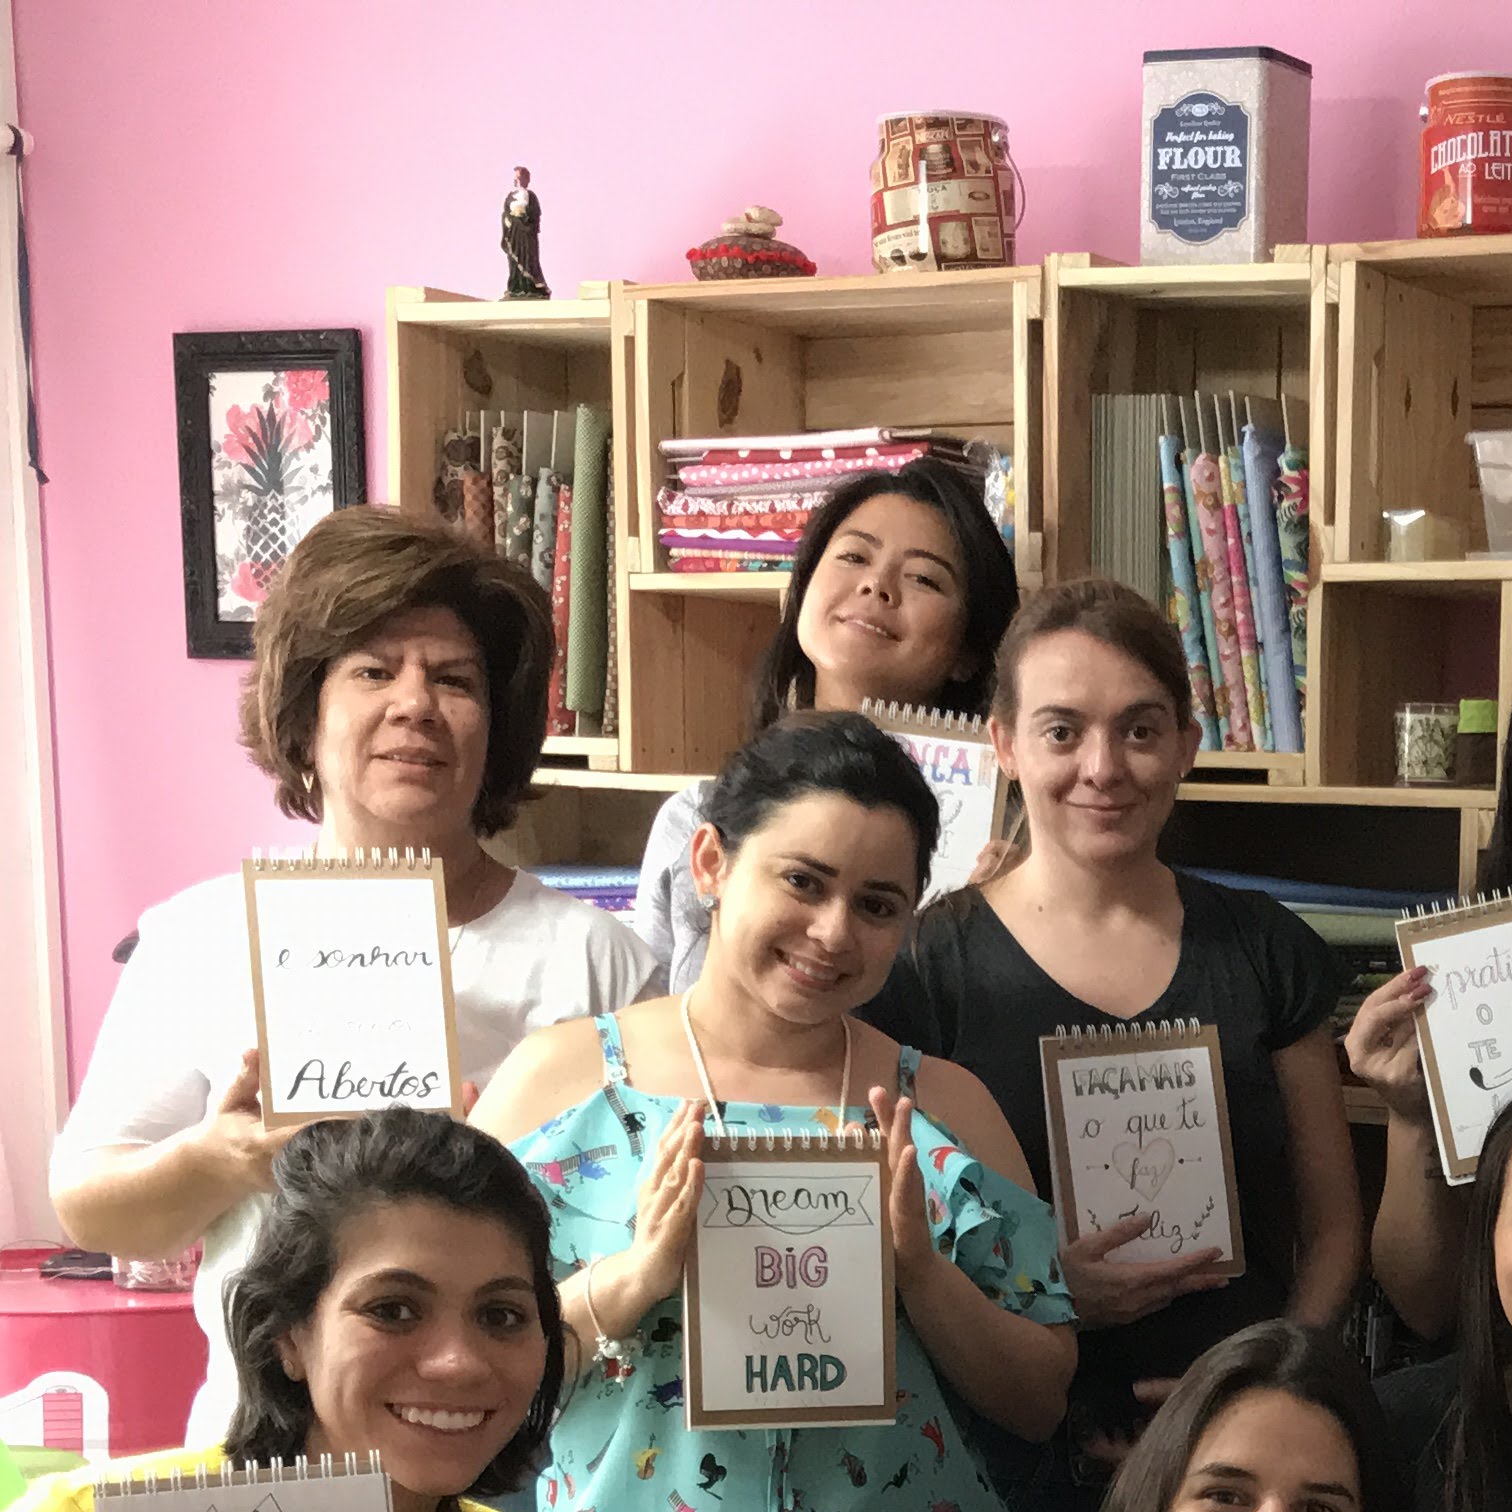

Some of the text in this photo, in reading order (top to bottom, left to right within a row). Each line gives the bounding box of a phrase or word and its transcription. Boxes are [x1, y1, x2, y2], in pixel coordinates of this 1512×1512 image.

[1157, 145, 1242, 170] FLOUR
[275, 945, 433, 969] e sonhar
[1475, 1003, 1494, 1025] O
[1468, 1038, 1501, 1063] TE
[286, 1058, 441, 1101] Abertos
[1125, 1112, 1171, 1150] que
[1176, 1095, 1206, 1130] te
[1129, 1157, 1168, 1190] faz
[721, 1184, 856, 1236] Dream
[745, 1353, 848, 1394] HARD
